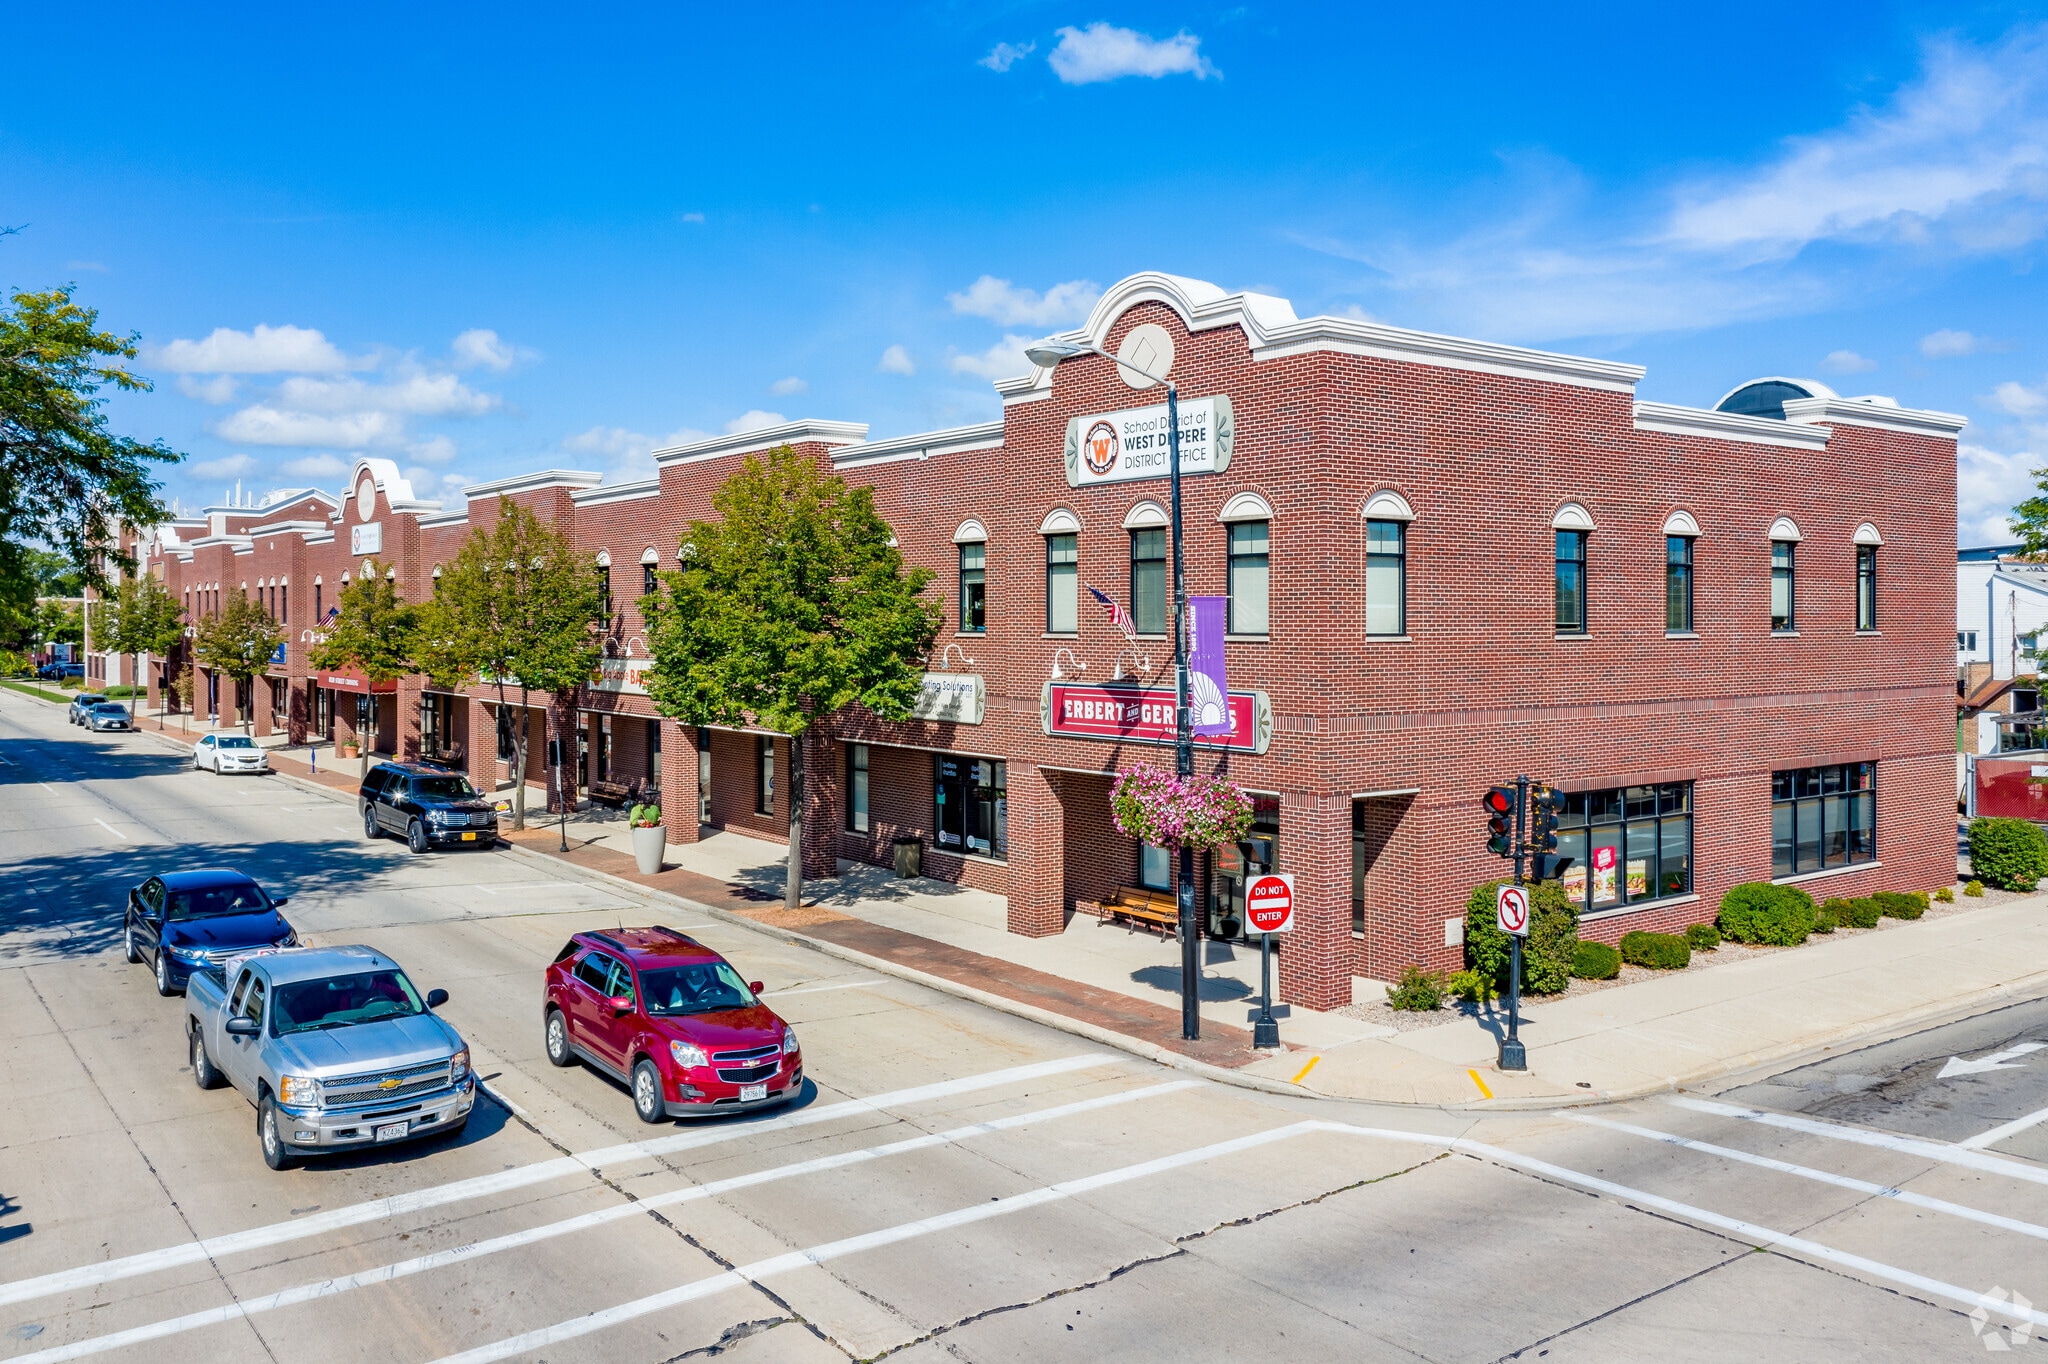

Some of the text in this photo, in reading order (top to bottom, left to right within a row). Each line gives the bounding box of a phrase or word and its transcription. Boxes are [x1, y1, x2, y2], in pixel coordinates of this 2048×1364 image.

[1124, 411, 1206, 434] School Dirict of
[1124, 435, 1154, 451] WEST
[1178, 428, 1206, 444] PERE
[1092, 438, 1111, 464] W
[1125, 448, 1206, 469] DISTRICT FFICE
[613, 668, 629, 681] Apple
[942, 681, 973, 692] Solutions
[1065, 700, 1125, 721] ERBERT
[1127, 708, 1139, 718] AND
[1255, 886, 1284, 896] DO NOT
[1257, 911, 1282, 922] ENTER
